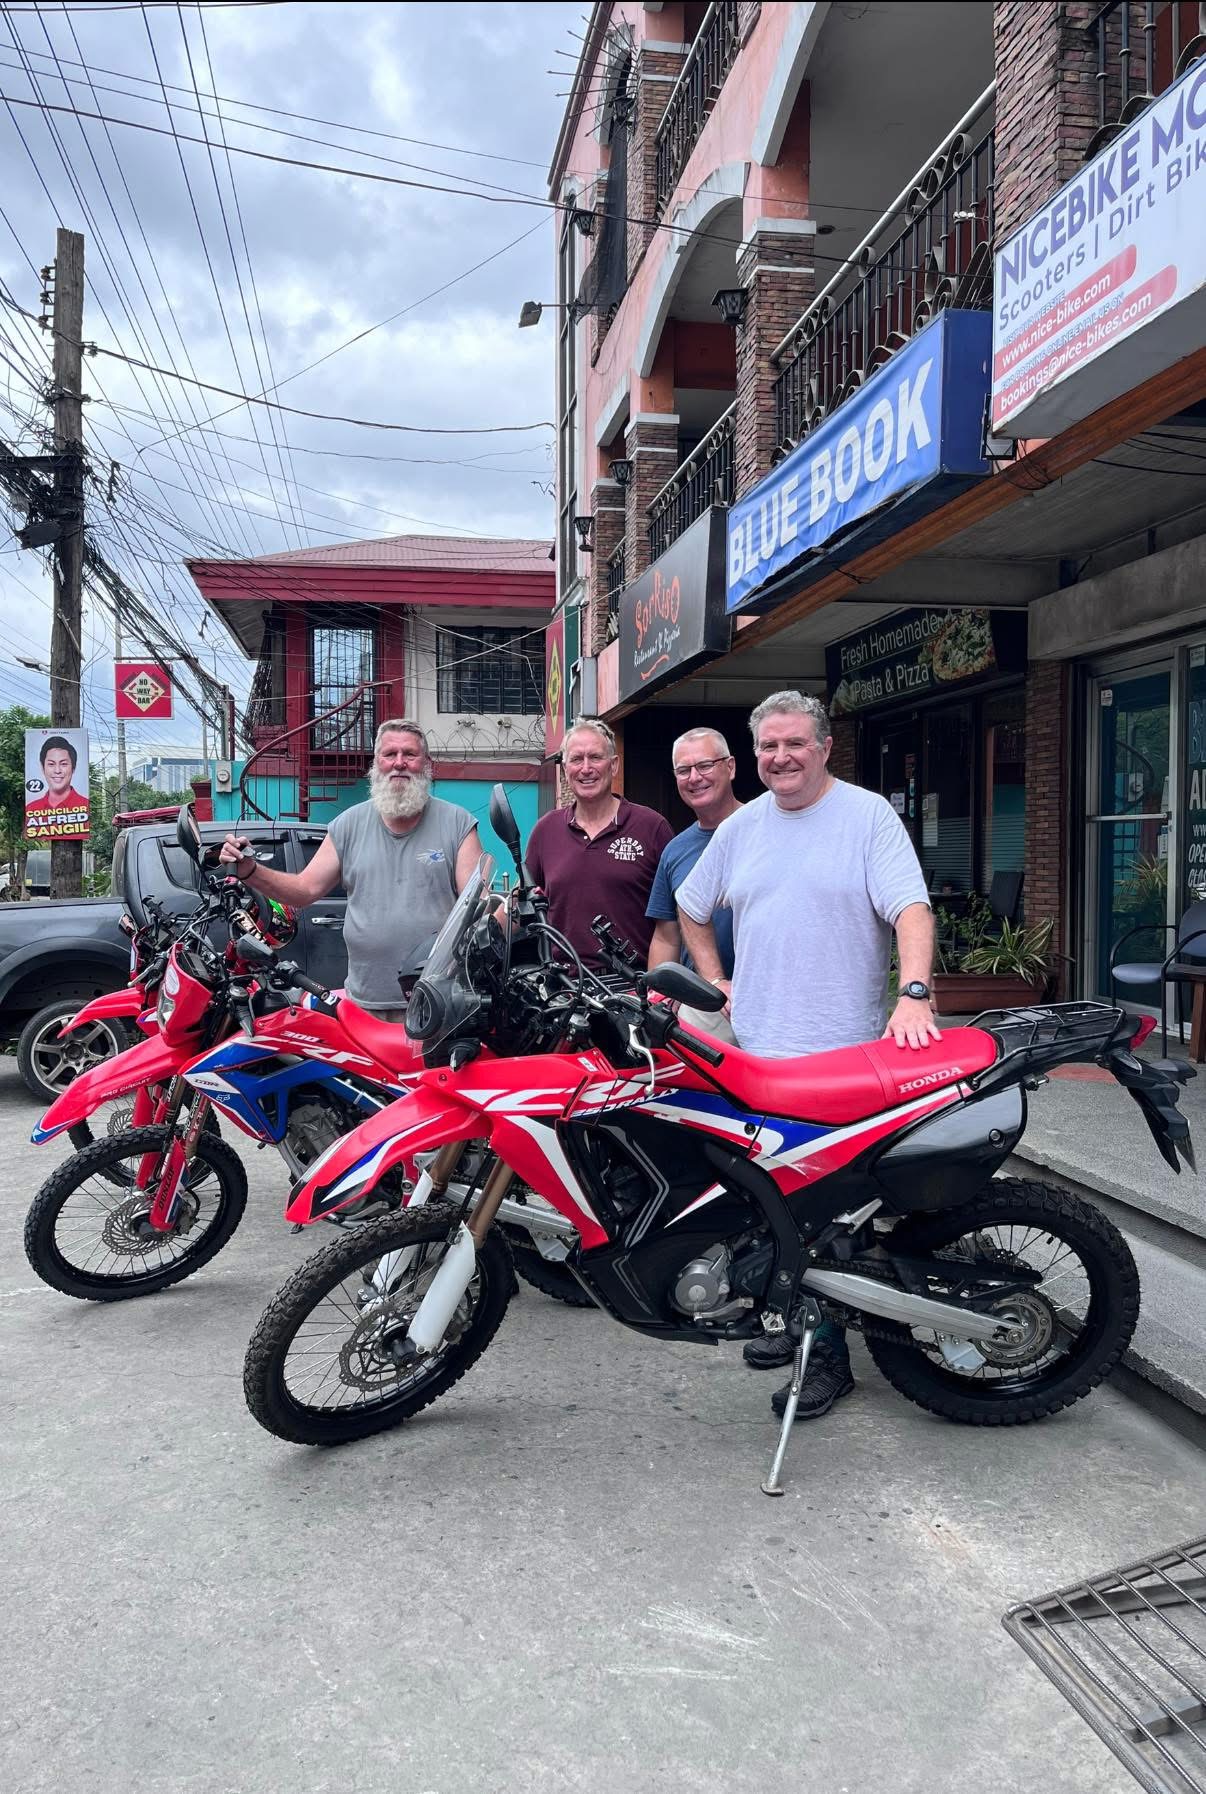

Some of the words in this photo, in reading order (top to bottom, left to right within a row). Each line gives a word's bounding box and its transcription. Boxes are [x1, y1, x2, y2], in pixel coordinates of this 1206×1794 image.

[1001, 130, 1140, 299] NICEBIKE
[1000, 242, 1085, 330] Scooters
[1109, 182, 1156, 240] Dirt
[1002, 274, 1111, 368] www.nice-bike.com
[1001, 292, 1152, 411] bookings@nice-bikes.com
[729, 474, 800, 588] BLUE
[809, 358, 934, 525] BOOK
[841, 638, 869, 670] Fresh
[869, 610, 940, 657] Homemade
[137, 687, 151, 695] WAY
[139, 678, 148, 686] NO
[853, 677, 882, 703] Pasta
[885, 668, 895, 693] &
[896, 662, 930, 689] Pizza
[137, 697, 151, 705] BAR
[29, 780, 41, 792] 22
[26, 806, 87, 818] COUNCILOR
[26, 813, 89, 827] ALFRED
[26, 823, 90, 838] SANGIL
[607, 837, 644, 857] SUPERDRY
[614, 851, 636, 861] STATE
[898, 1066, 965, 1095] HONDA
